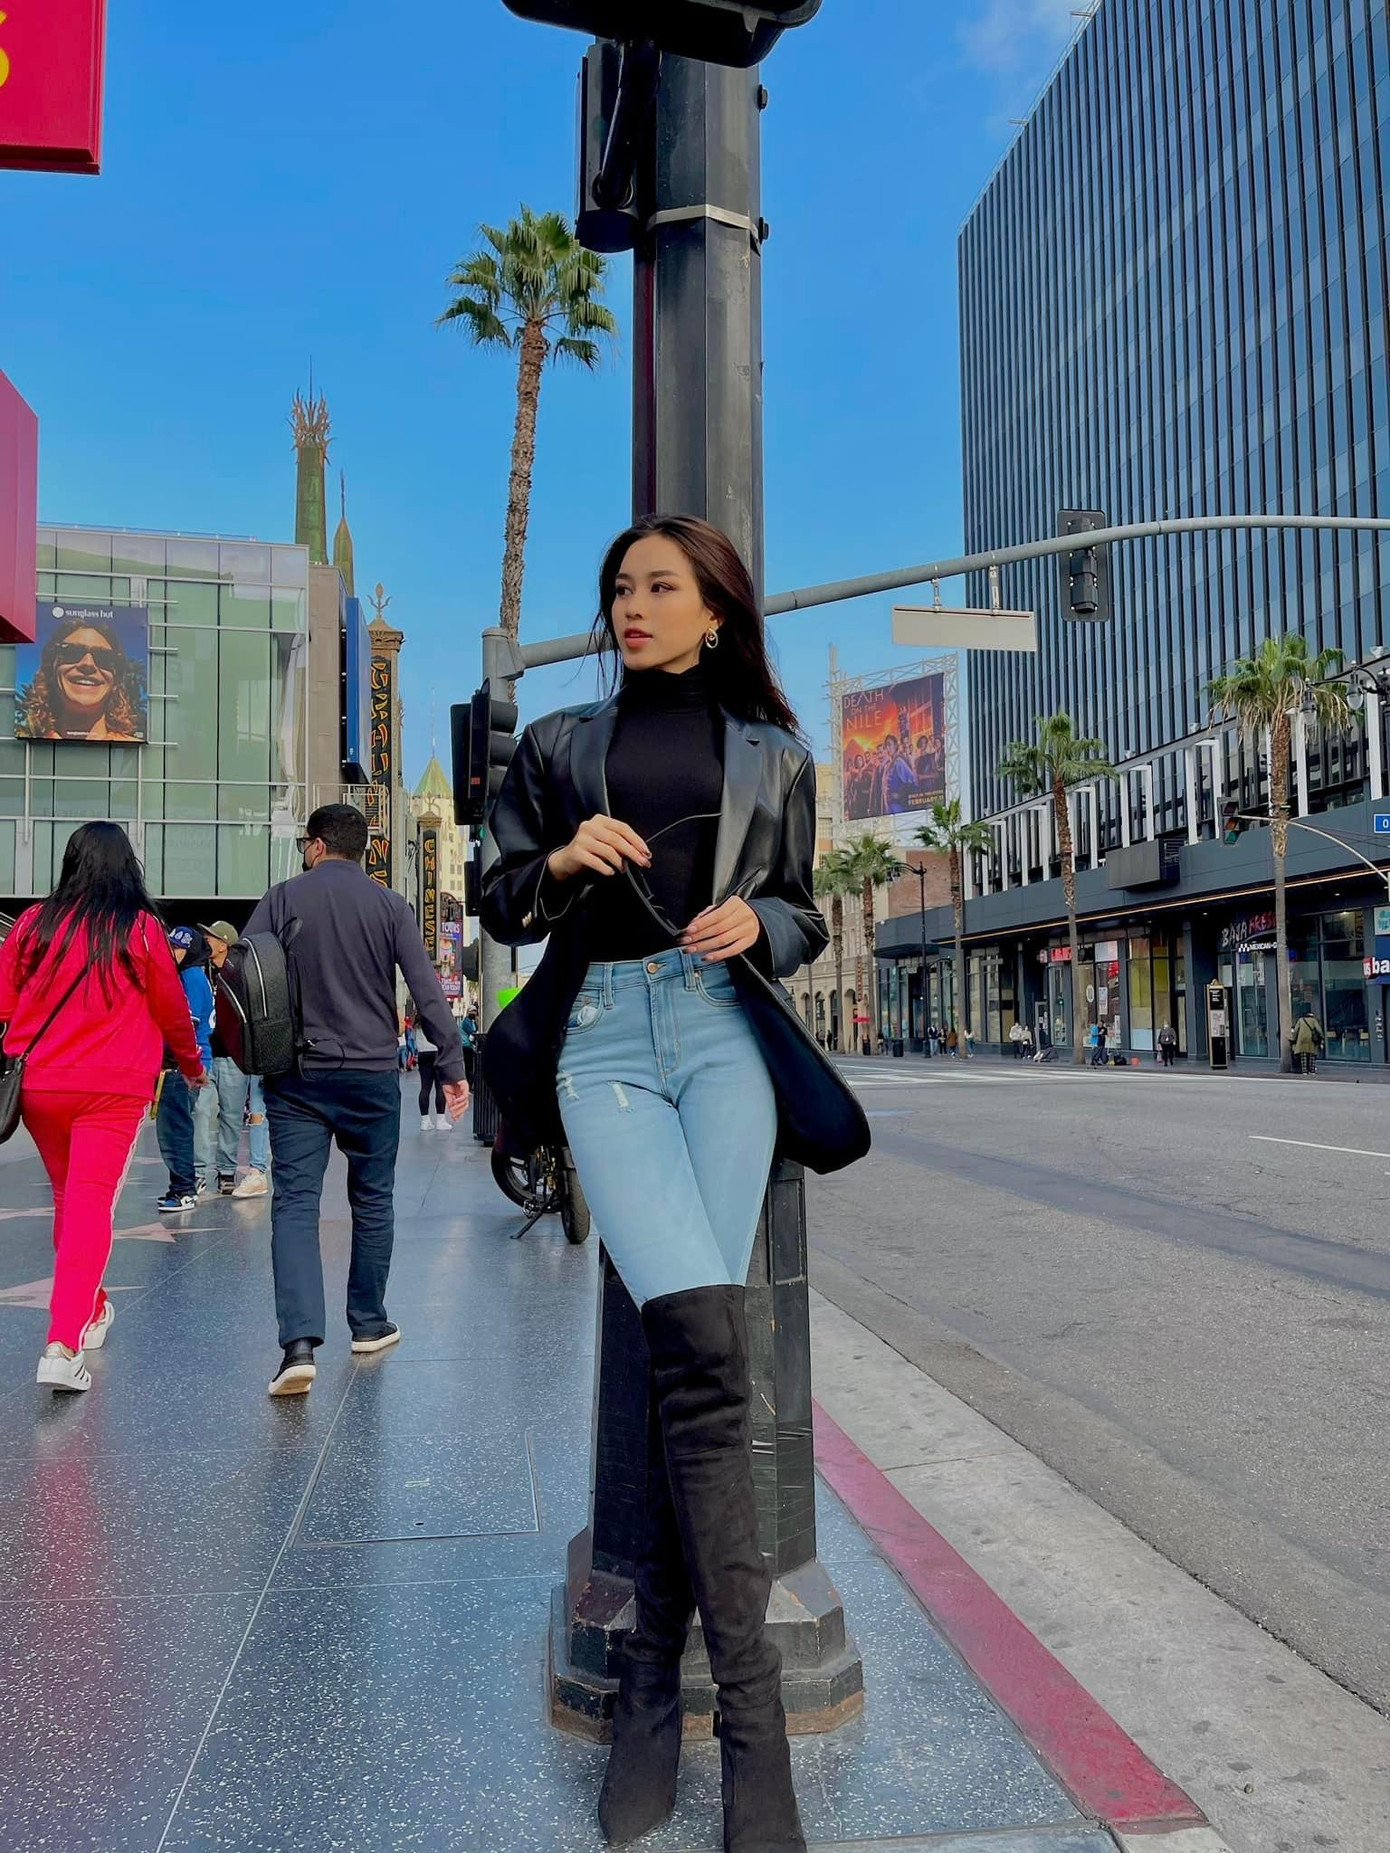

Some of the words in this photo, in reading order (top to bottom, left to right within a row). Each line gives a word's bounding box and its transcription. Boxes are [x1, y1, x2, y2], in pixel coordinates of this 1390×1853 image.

[65, 608, 99, 619] sunglass
[100, 609, 114, 619] hut
[843, 689, 884, 709] DEATH
[846, 710, 882, 731] NILE
[424, 838, 436, 953] CHINESE
[1221, 921, 1248, 948] BAJA
